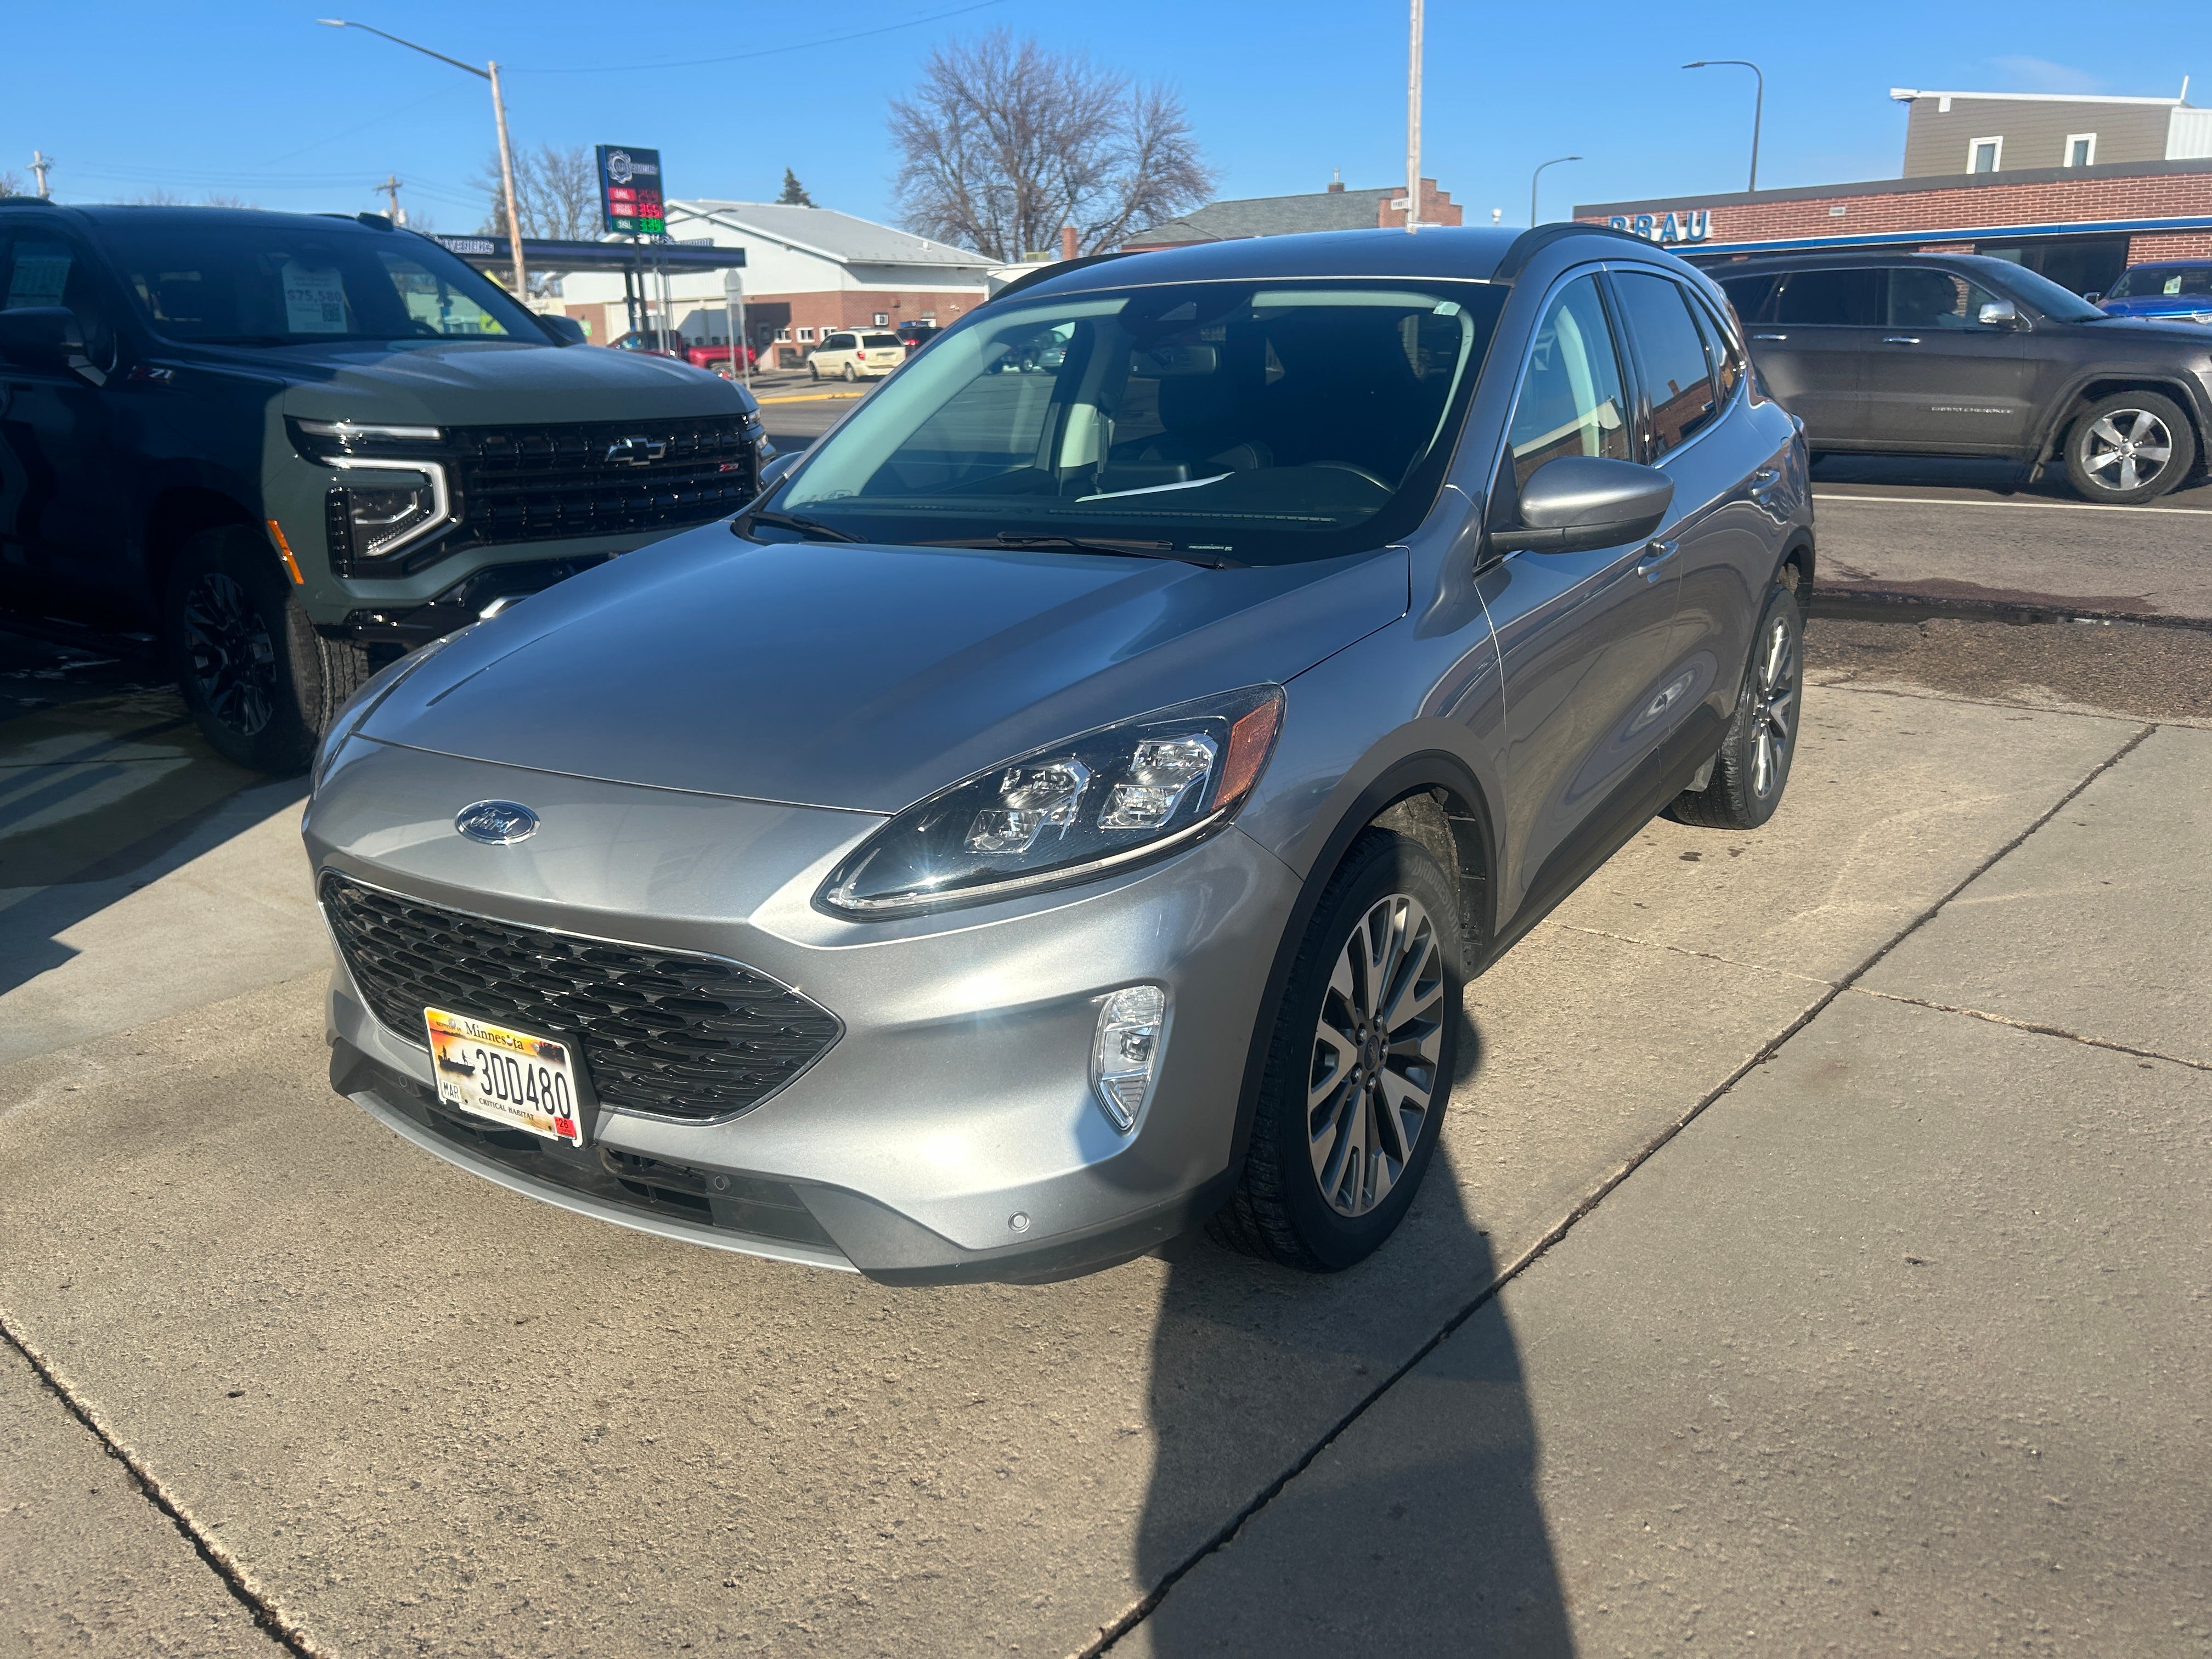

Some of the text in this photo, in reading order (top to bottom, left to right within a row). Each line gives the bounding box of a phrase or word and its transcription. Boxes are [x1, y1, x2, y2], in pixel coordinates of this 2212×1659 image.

[471, 807, 520, 834] Ford
[464, 1020, 524, 1050] Minnesota
[443, 1082, 459, 1100] MAR
[476, 1048, 571, 1119] 3DD480
[479, 1098, 534, 1120] CRITICAL HABITAT
